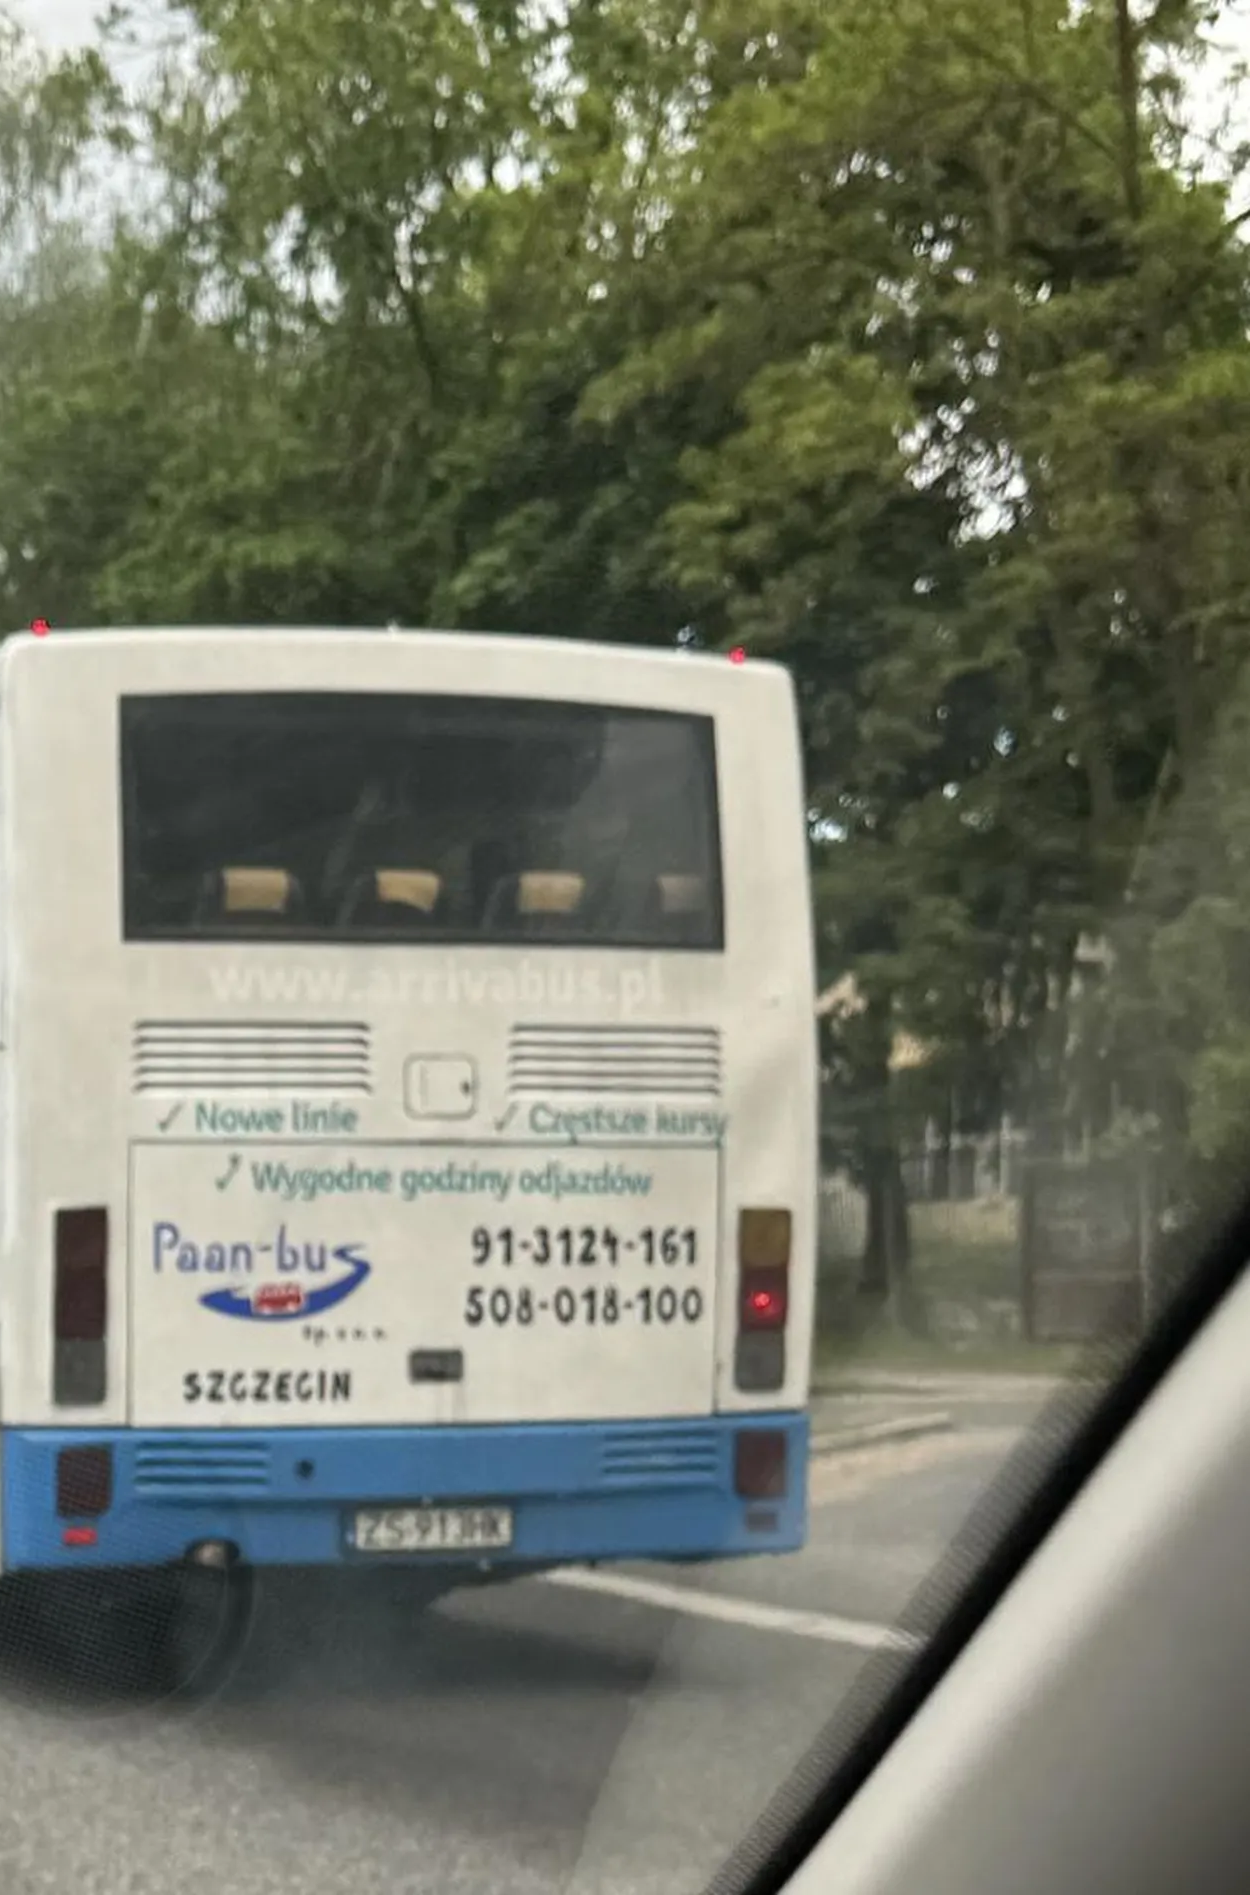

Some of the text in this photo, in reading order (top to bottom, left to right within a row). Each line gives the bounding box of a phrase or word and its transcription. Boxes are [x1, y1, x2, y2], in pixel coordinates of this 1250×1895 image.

[210, 959, 665, 1017] www.arrivabus.pl
[196, 1100, 358, 1132] Nowe linie
[656, 1103, 728, 1146] kursy
[252, 1159, 653, 1201] Wygodne godziny odjazdów
[471, 1226, 696, 1267] 91-3124-161
[464, 1285, 703, 1327] 508-018-100
[183, 1370, 352, 1402] SZCZECIN
